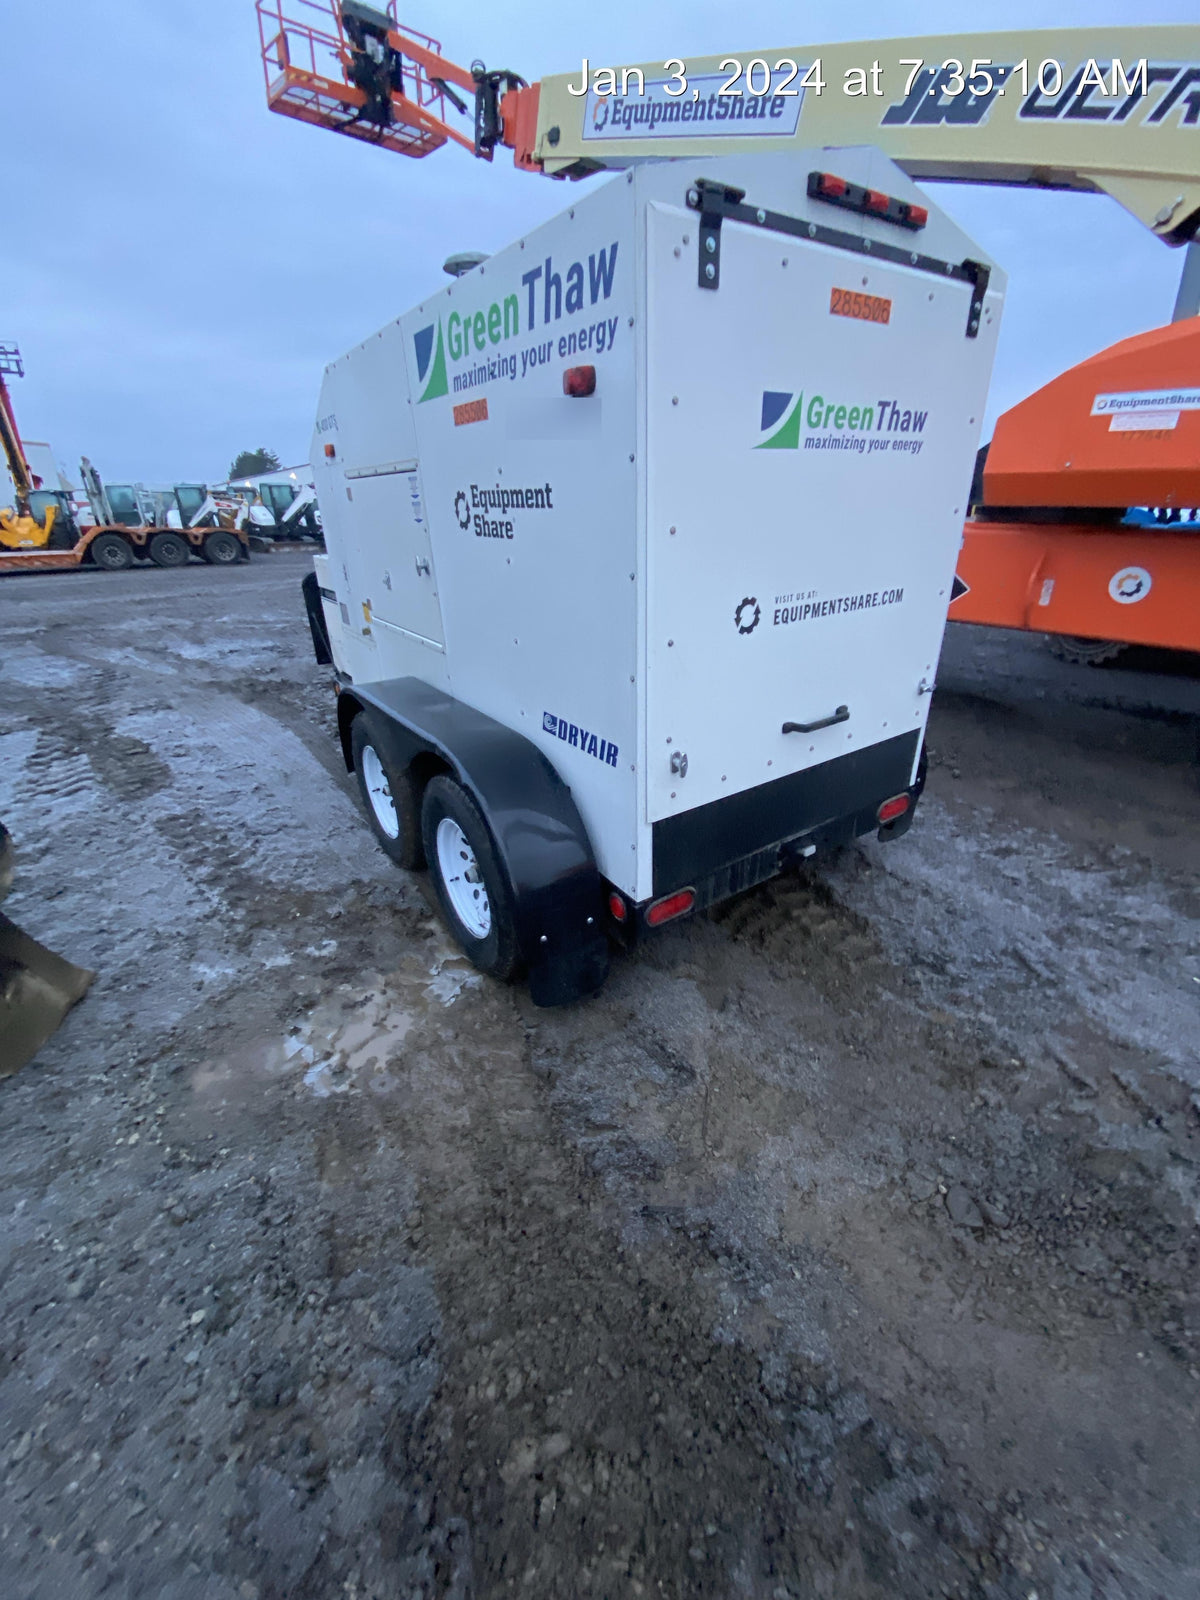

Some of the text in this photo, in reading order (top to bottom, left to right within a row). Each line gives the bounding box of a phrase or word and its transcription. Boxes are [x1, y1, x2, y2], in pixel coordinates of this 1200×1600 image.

[610, 93, 786, 130] EquipmentShare
[447, 241, 619, 361] Green Thaw
[830, 288, 891, 323] 285506
[453, 316, 619, 392] maximizing your energy
[806, 395, 928, 433] Green Thaw
[804, 434, 924, 454] maximizing your energy
[470, 483, 553, 514] Equipment
[473, 514, 514, 539] Share
[773, 588, 904, 625] EQUIPMENTSHARE.COM
[775, 593, 794, 604] VISIT
[796, 592, 806, 601] US
[558, 718, 619, 768] DRYAIR
